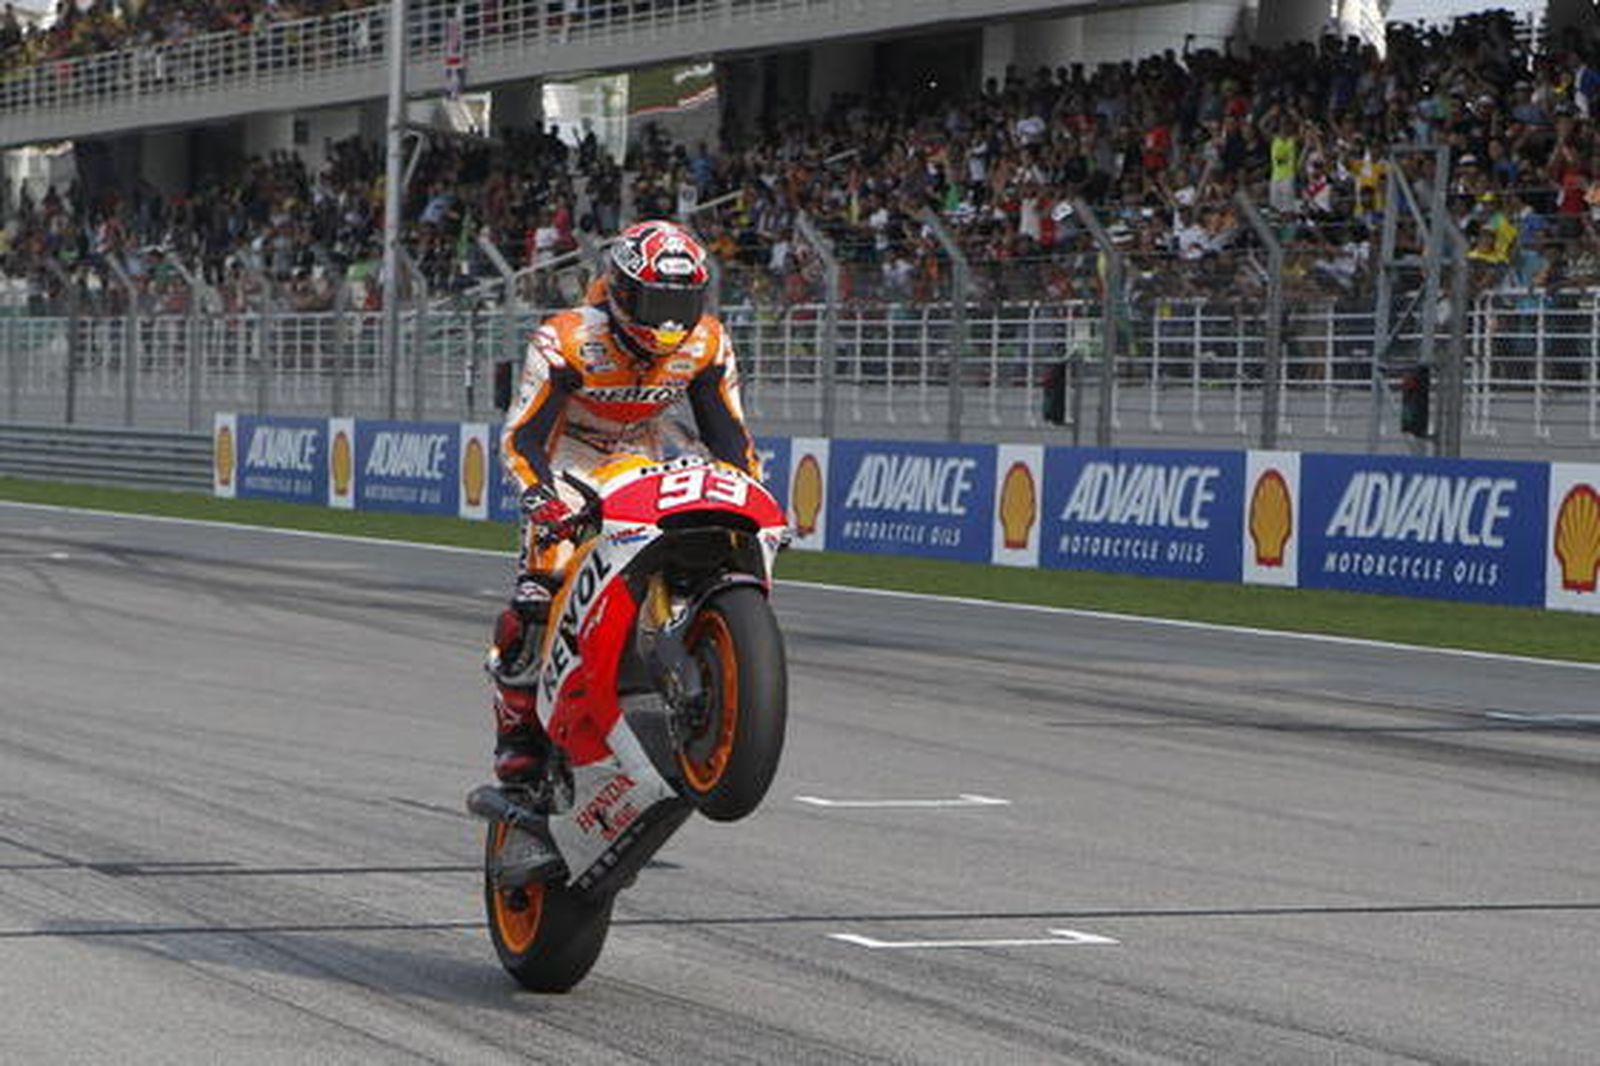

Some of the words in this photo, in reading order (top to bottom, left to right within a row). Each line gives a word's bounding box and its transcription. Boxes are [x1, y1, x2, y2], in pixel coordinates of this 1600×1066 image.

[245, 426, 319, 473] ADVANCE
[364, 431, 449, 480] ADVANCE
[656, 470, 750, 510] 93
[845, 454, 976, 515] ADVANCE
[1060, 461, 1221, 530] ADVANCE
[1325, 471, 1518, 547] ADVANCE
[843, 520, 926, 544] MOTORCYCLE
[930, 526, 961, 548] OILS
[1059, 534, 1160, 561] MOTORCYCLE
[1166, 540, 1206, 564] OILS
[1323, 550, 1444, 580] MOTORCYCLE
[1453, 559, 1499, 587] OILS
